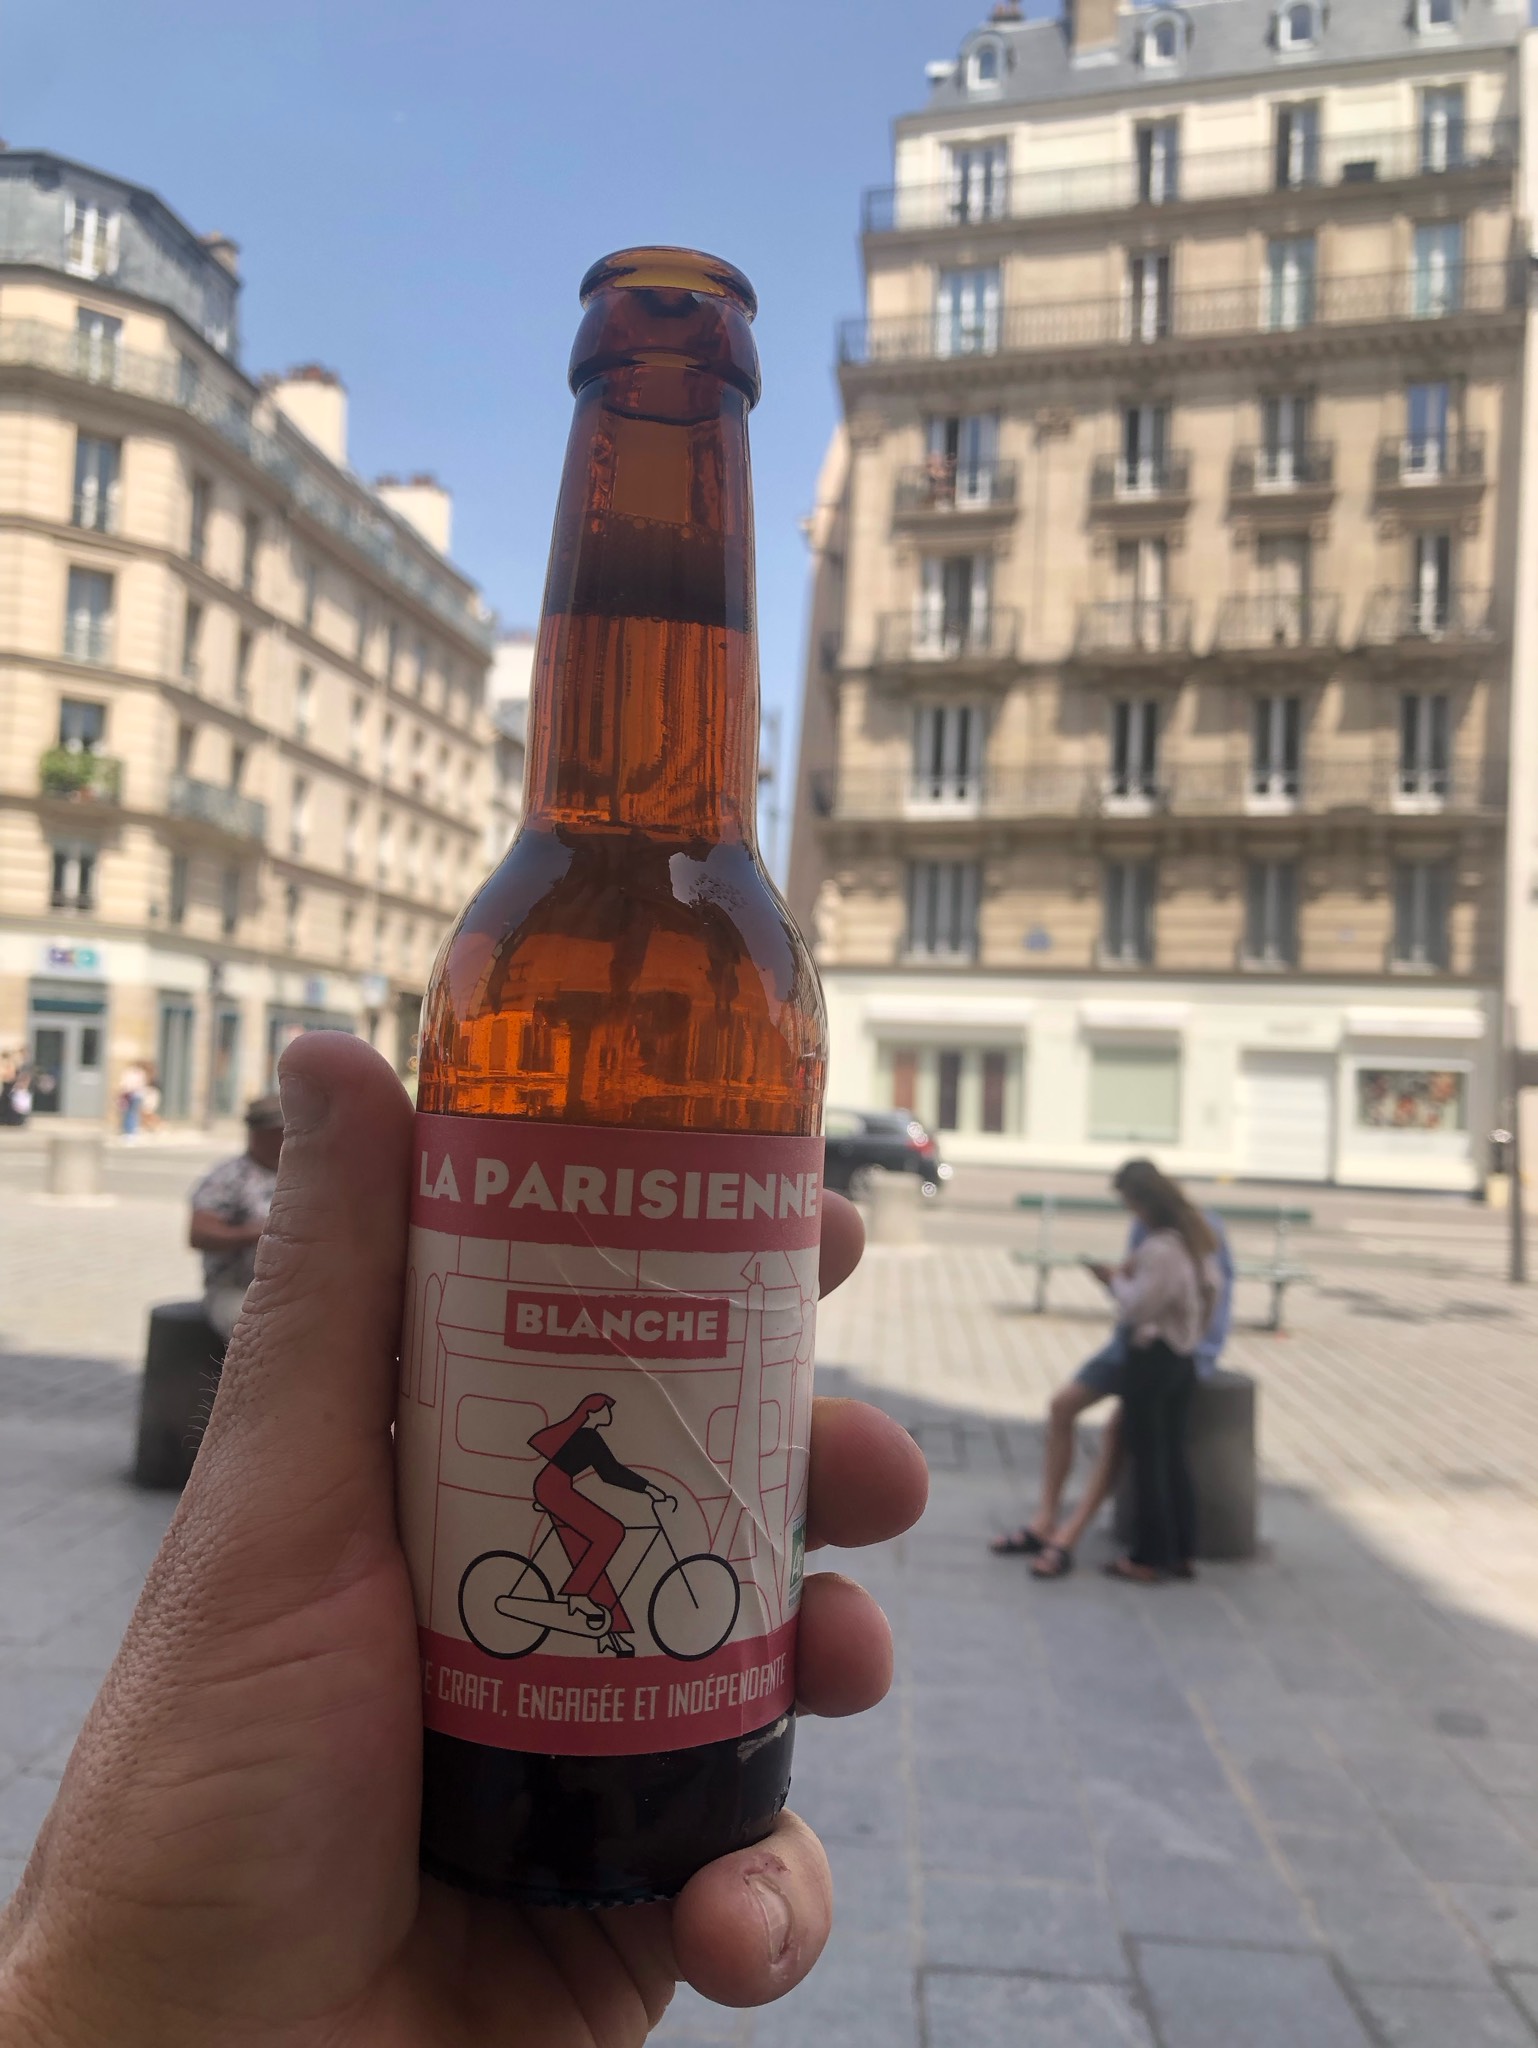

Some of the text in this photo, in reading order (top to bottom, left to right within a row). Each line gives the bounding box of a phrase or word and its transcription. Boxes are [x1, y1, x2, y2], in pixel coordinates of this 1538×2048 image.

[419, 1151, 818, 1220] LA PARISIENNE
[516, 1303, 719, 1342] BLANCHE
[517, 1683, 626, 1722] ENGAGÉE
[633, 1686, 661, 1721] ET
[667, 1652, 786, 1718] INDÉPENDANTE
